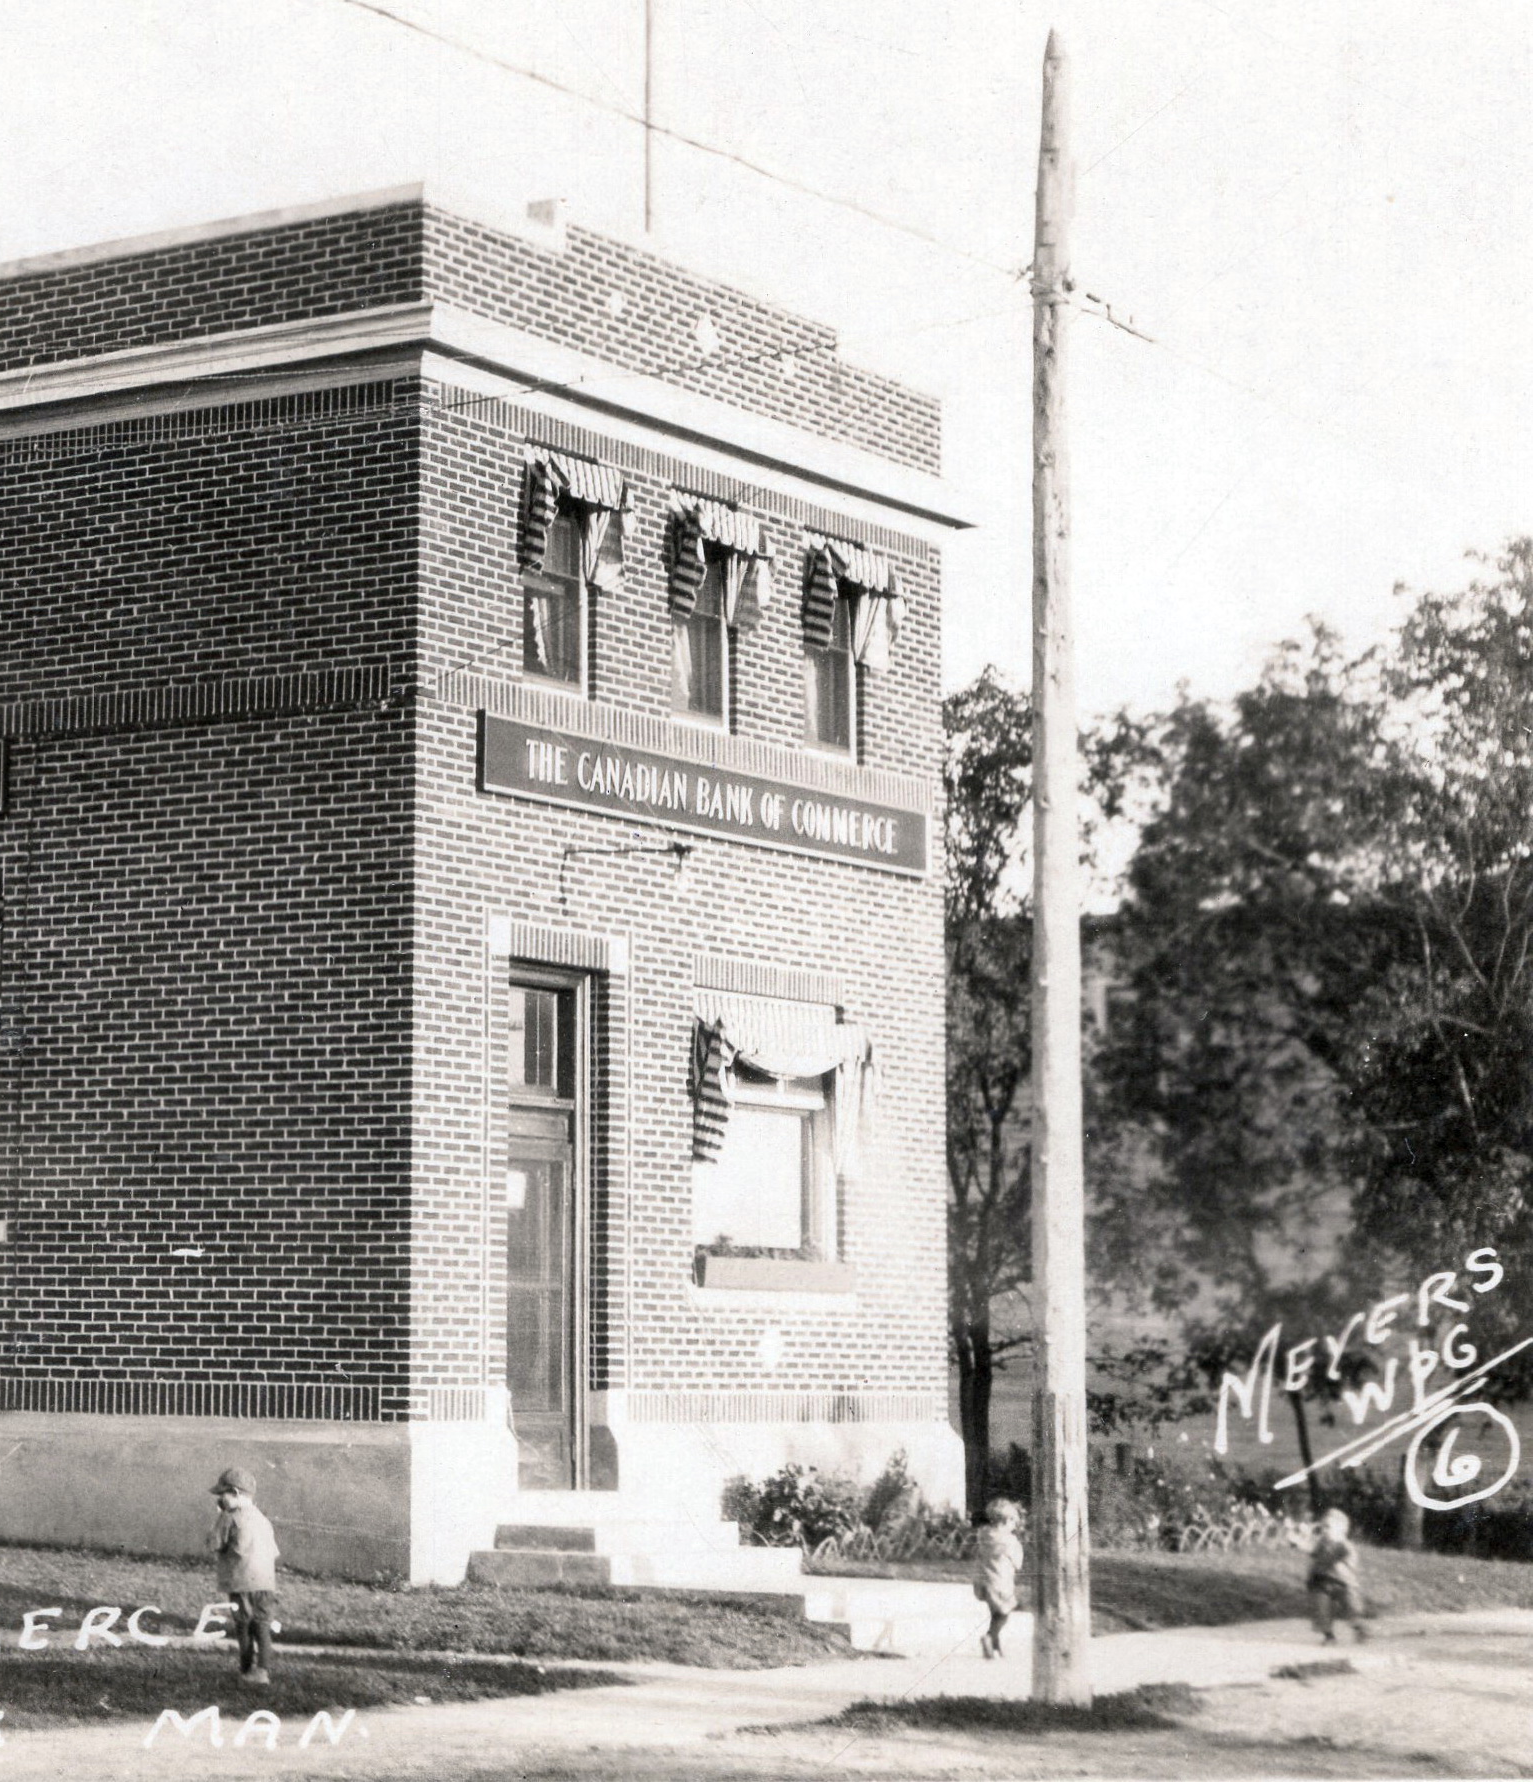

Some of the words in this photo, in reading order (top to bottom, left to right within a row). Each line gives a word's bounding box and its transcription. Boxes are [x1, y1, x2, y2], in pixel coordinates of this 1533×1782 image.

[525, 737, 569, 787] THE
[576, 751, 689, 812] CANADIAN
[695, 776, 755, 828] BANK
[760, 793, 787, 831] OF
[791, 799, 900, 856] COMMERCE
